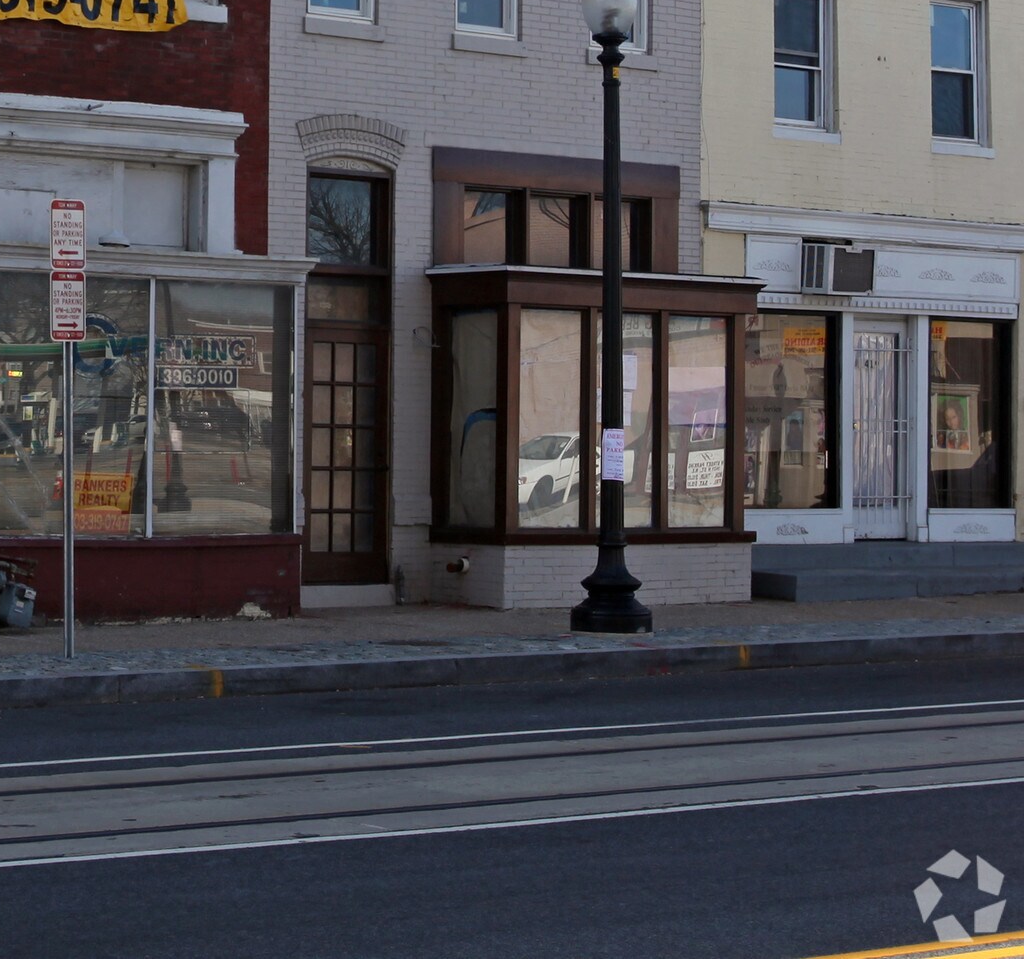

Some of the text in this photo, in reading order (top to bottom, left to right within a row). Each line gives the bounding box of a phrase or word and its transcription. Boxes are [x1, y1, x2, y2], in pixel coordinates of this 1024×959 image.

[63, 212, 72, 220] NO
[53, 221, 83, 229] STANDING
[74, 479, 128, 493] BANKERS
[78, 492, 121, 507] REALTY
